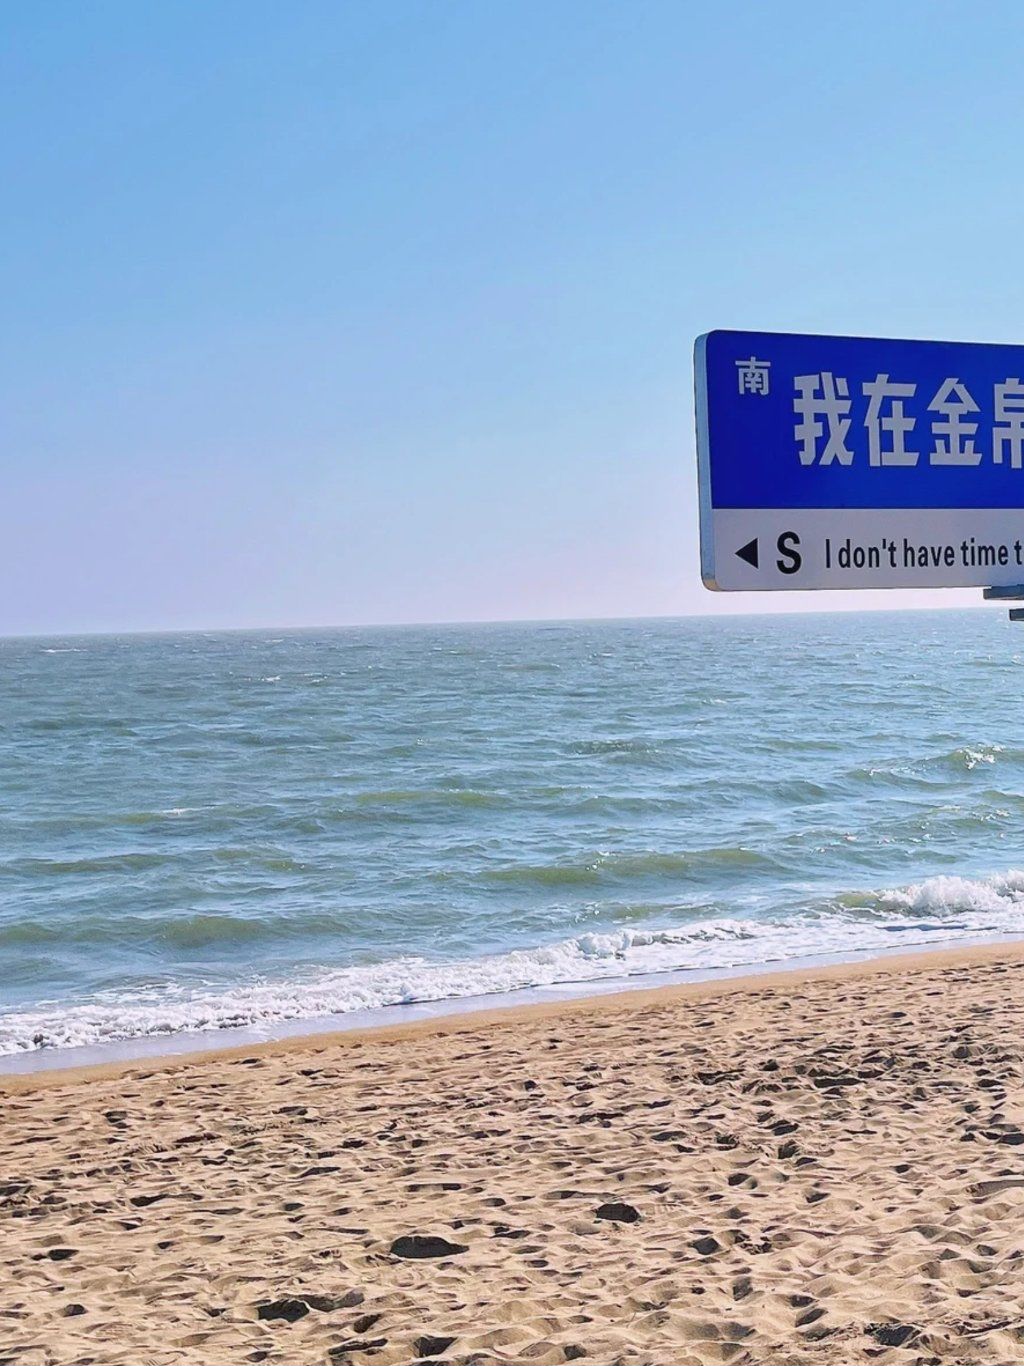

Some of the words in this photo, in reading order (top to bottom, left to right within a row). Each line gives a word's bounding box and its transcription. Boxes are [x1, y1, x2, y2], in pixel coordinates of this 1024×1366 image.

[734, 357, 771, 396] 南
[775, 530, 803, 575] S
[824, 537, 832, 569] I
[838, 537, 898, 569] don't
[902, 537, 956, 568] have
[959, 536, 1010, 567] time
